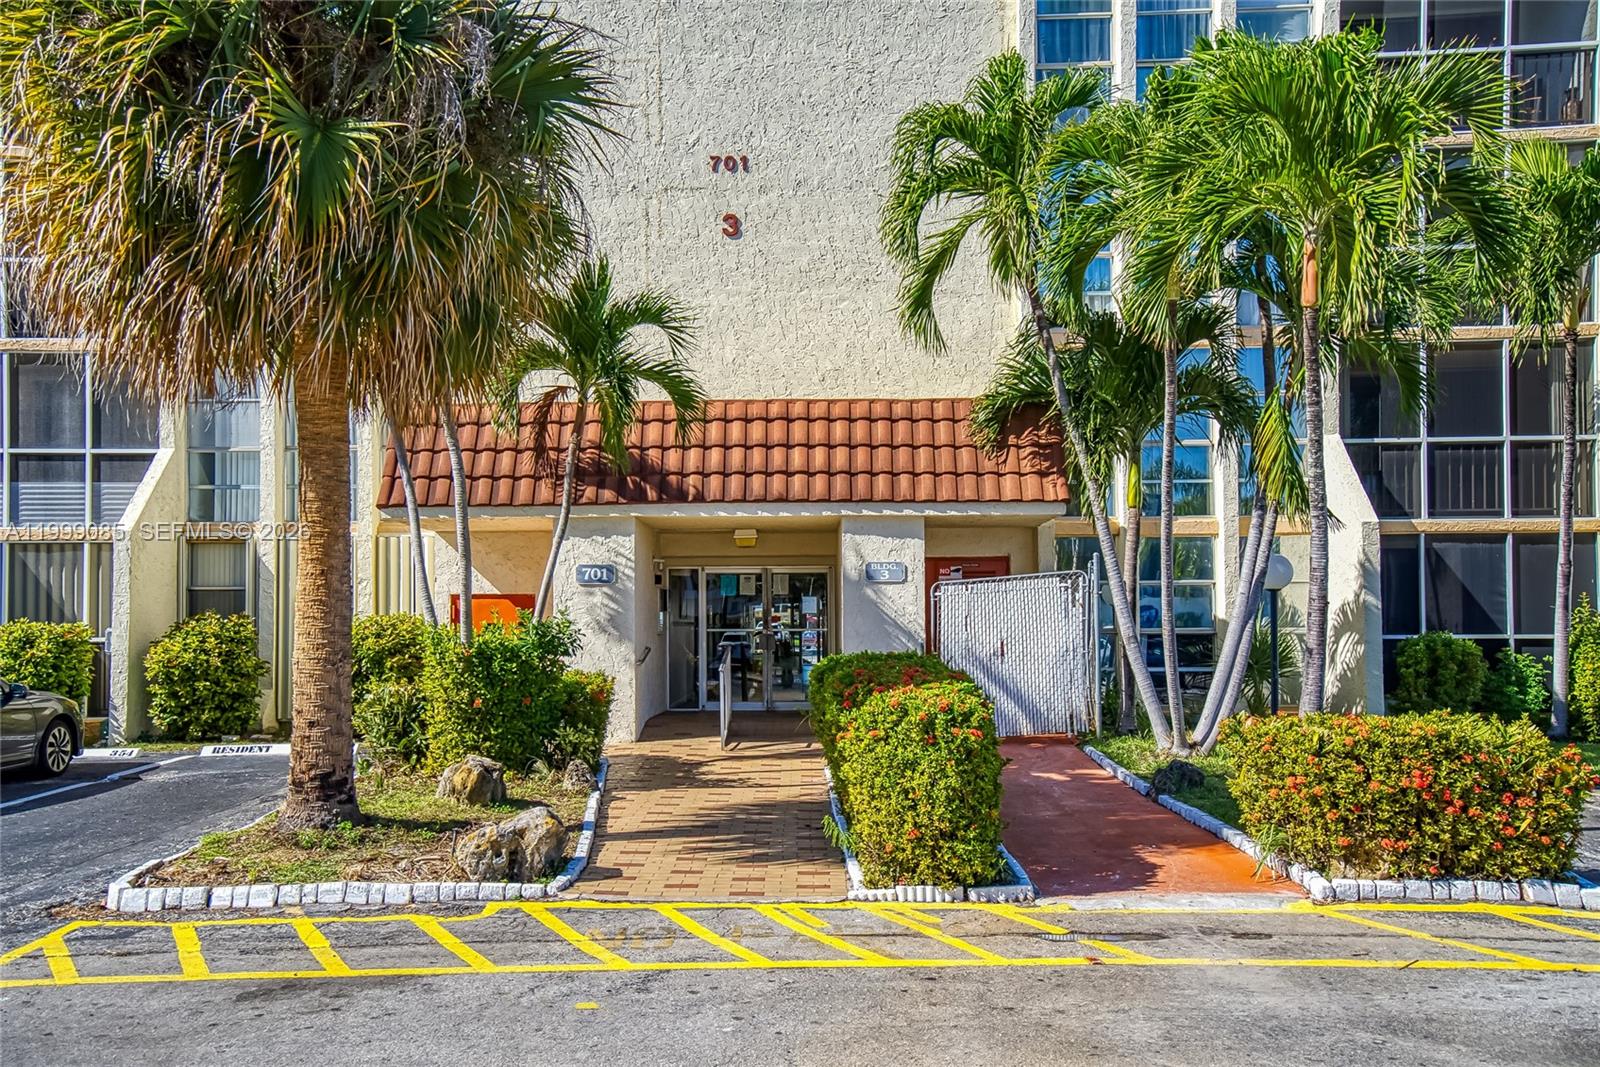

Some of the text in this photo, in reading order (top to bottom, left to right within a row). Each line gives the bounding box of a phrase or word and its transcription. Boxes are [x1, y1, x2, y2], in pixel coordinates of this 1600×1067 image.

[709, 155, 750, 173] 701
[722, 213, 742, 239] 3
[582, 567, 608, 580] 701
[880, 570, 889, 580] 3
[212, 745, 272, 754] RESIDENT
